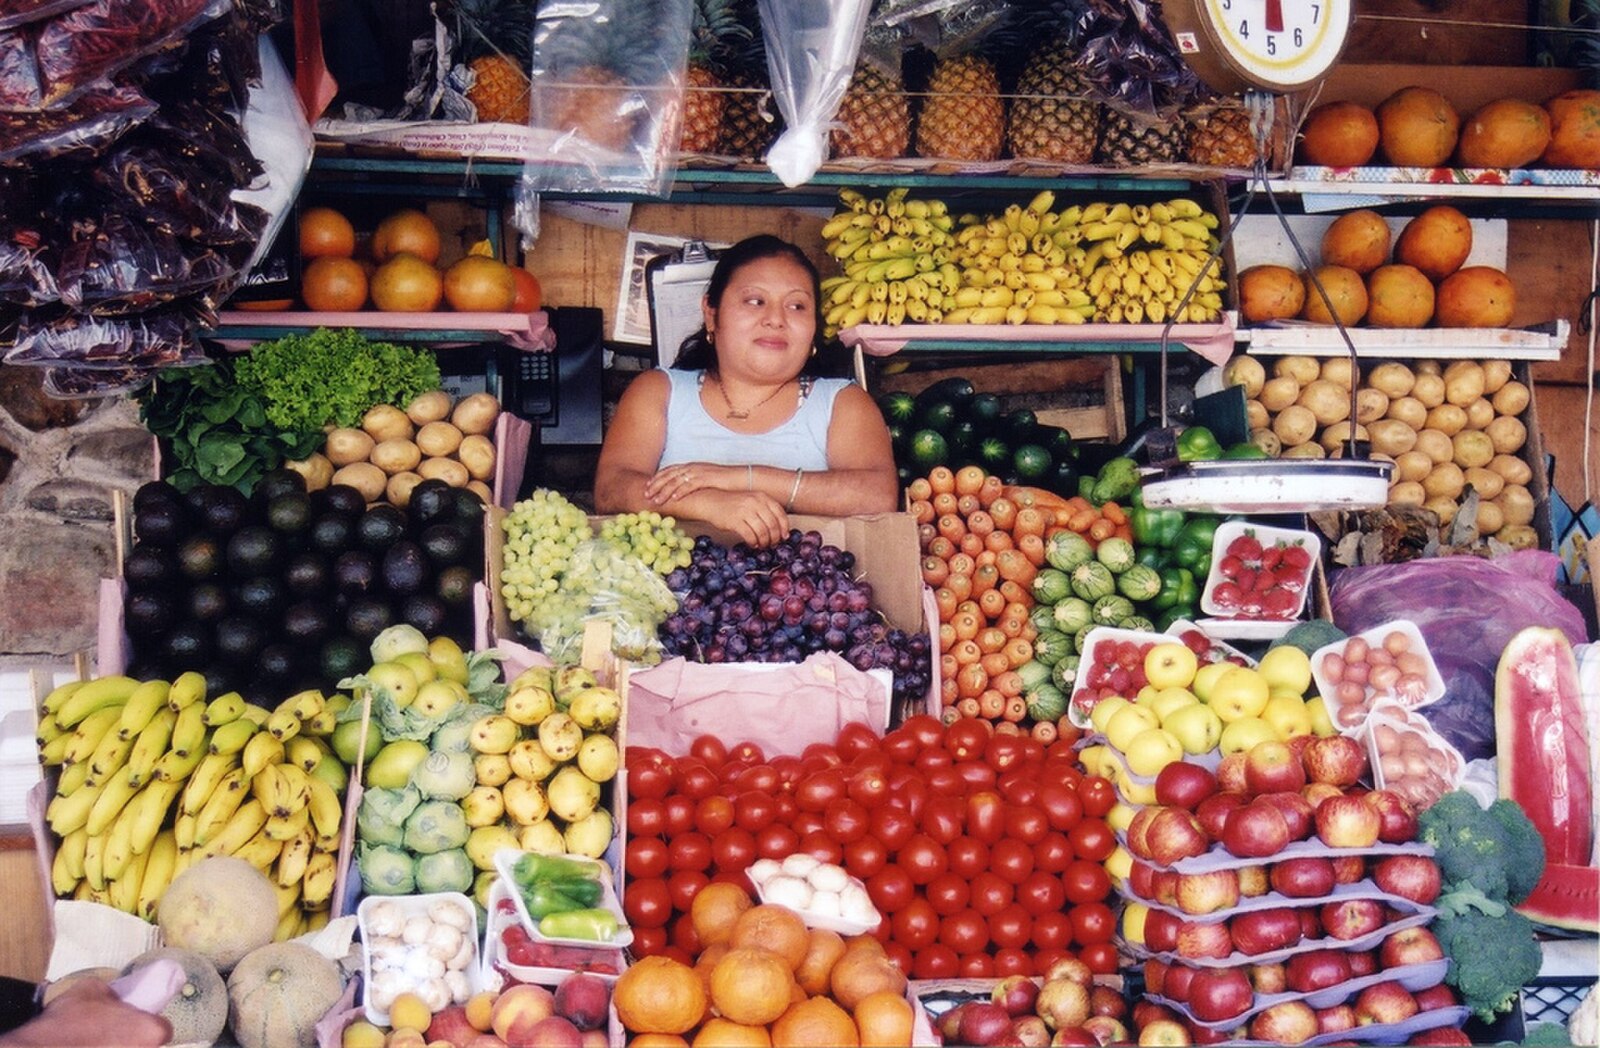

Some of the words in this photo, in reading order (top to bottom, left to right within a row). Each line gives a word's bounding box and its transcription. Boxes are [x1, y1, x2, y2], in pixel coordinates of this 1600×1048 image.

[1311, 4, 1319, 24] 7
[1240, 19, 1249, 40] 4
[1294, 27, 1303, 48] 6
[1266, 35, 1276, 55] 5
